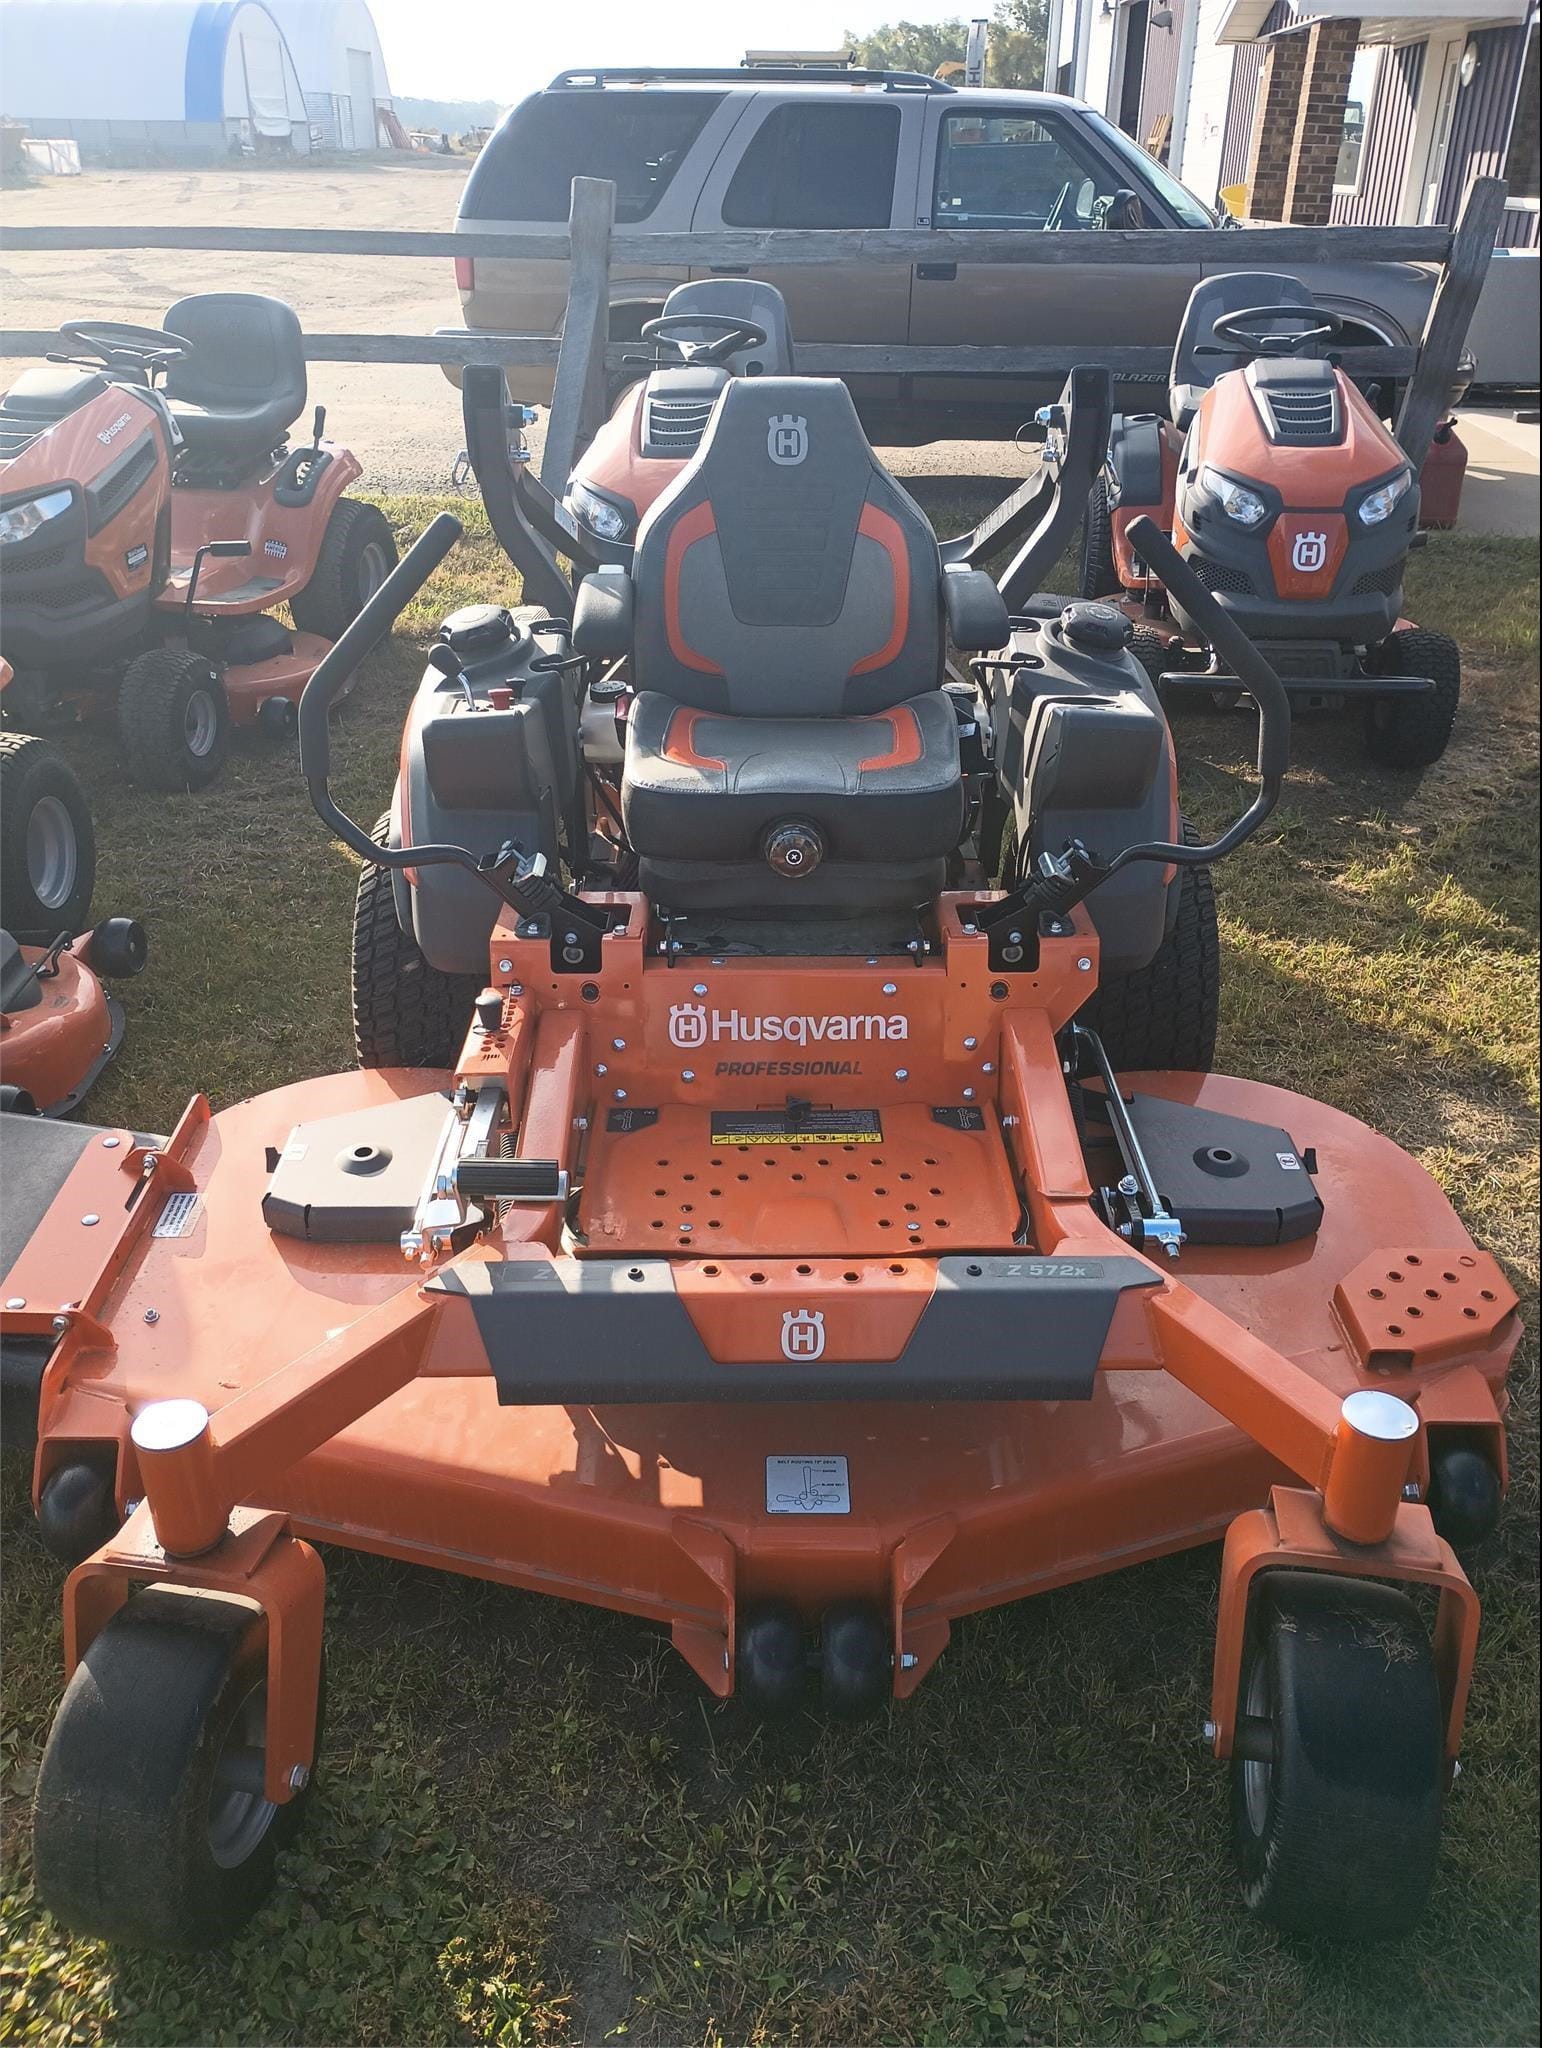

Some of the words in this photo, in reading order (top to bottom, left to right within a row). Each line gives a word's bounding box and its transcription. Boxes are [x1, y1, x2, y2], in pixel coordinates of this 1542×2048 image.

[1113, 373, 1167, 382] BLAZER
[711, 1009, 908, 1047] Husqvarna
[715, 1060, 863, 1077] PROFESSIONAL
[1007, 1264, 1023, 1276] Z
[1029, 1264, 1087, 1276] 572x
